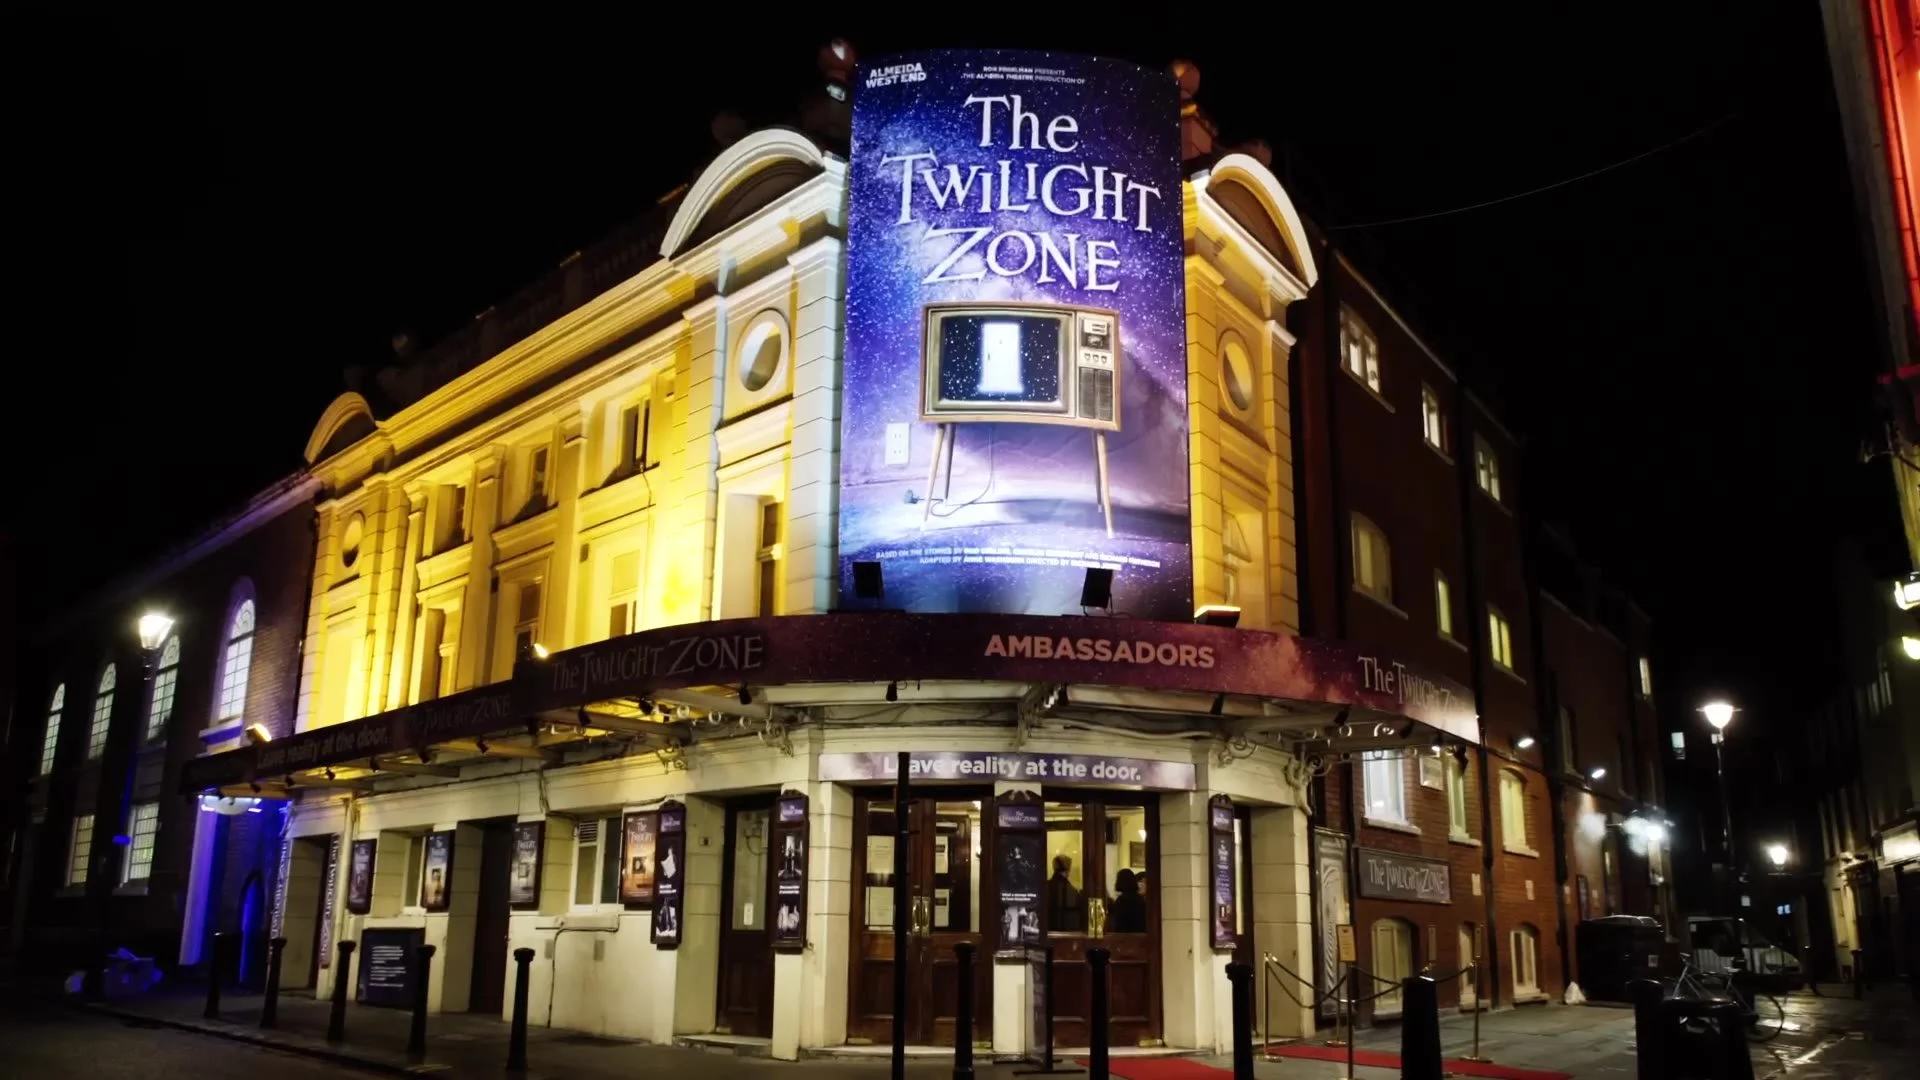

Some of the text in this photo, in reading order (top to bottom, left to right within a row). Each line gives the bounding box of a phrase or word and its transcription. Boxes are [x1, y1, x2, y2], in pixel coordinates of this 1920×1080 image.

[865, 71, 927, 89] WEST END
[870, 62, 923, 79] ALMEIDA
[1034, 68, 1066, 76] PRESENTS
[1034, 75, 1075, 84] PRODUCTION
[963, 93, 1079, 153] The
[920, 222, 1121, 293] ZONE
[876, 550, 898, 559] BASED
[919, 555, 951, 564] ADAPTED
[551, 660, 578, 693] The
[666, 634, 764, 676] ZONE
[983, 632, 1216, 669] AMBASSADORS
[1357, 654, 1394, 695] The
[321, 734, 334, 755] at
[335, 731, 355, 752] the
[356, 723, 389, 748] door.
[883, 756, 1141, 780] Lave reality at the door.
[1367, 858, 1385, 886] The
